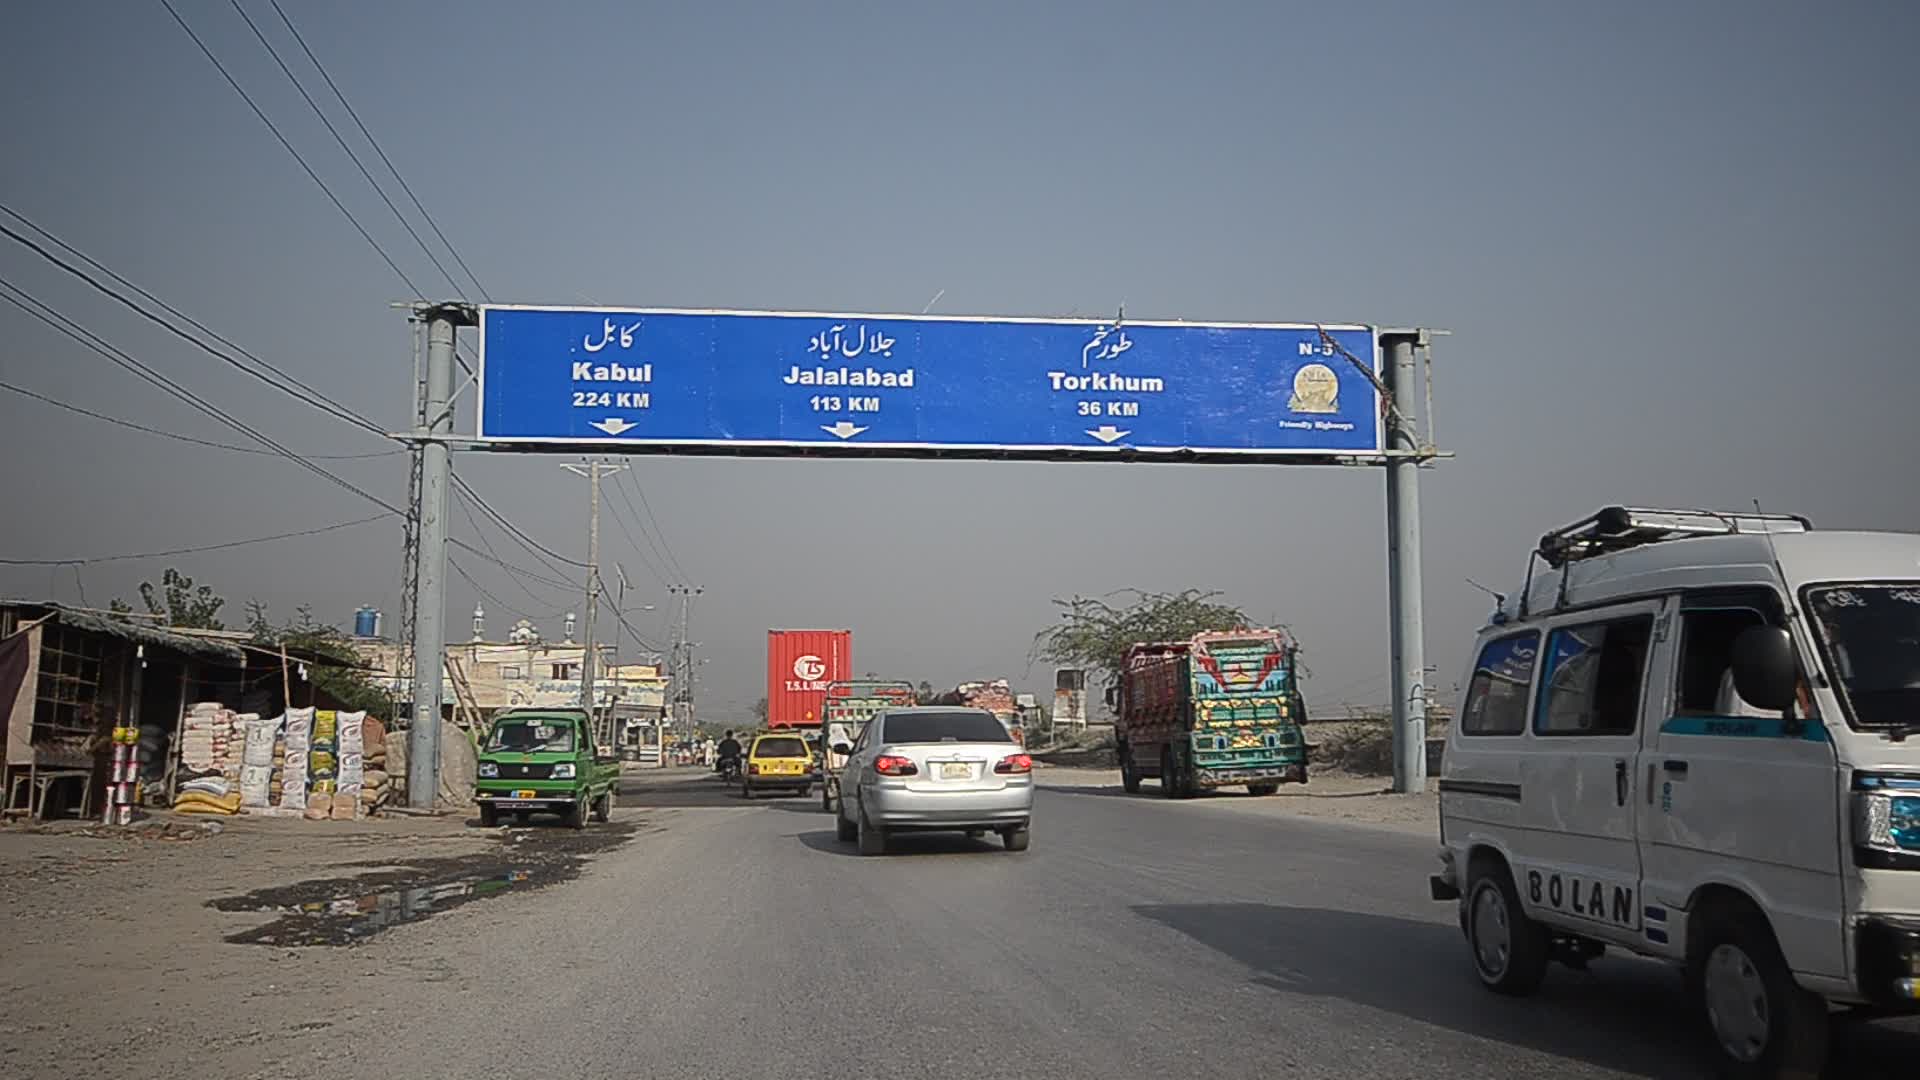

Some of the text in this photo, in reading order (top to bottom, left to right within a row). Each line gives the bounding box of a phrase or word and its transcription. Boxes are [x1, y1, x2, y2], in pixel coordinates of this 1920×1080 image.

[583, 317, 642, 352] کابل
[1298, 342, 1334, 356] N-5
[572, 361, 652, 382] Kabul
[783, 365, 914, 387] Jalalabad
[1047, 371, 1164, 392] Torkhum
[572, 391, 650, 408] 224 KM
[810, 395, 880, 412] 113 KM
[1078, 401, 1139, 417] 36 KM
[1279, 421, 1354, 432] Friendly Highways
[1528, 870, 1633, 923] BOLAN
